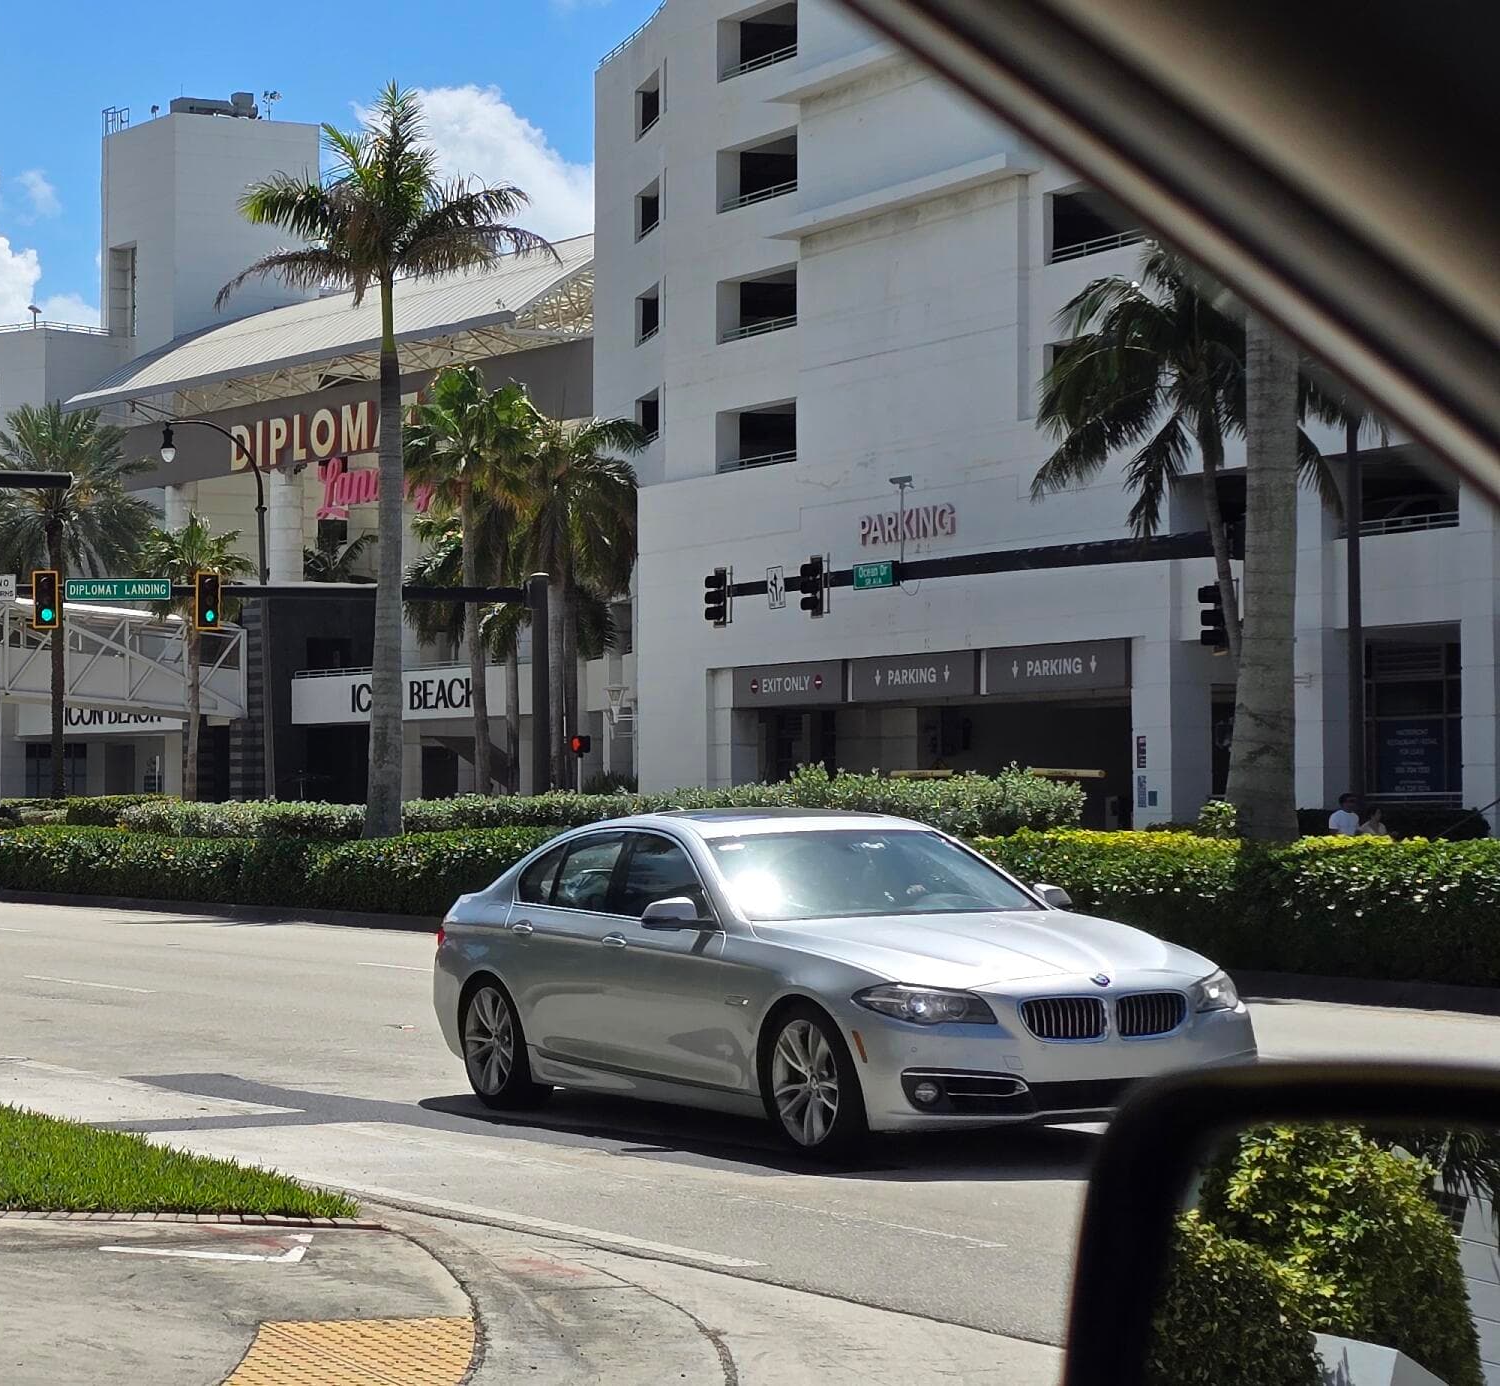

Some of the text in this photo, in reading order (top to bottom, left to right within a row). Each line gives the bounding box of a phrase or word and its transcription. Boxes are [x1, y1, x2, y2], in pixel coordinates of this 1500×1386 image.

[230, 391, 419, 472] DIPLOM
[859, 502, 957, 547] PARKING
[858, 564, 888, 578] Ocean Dr
[69, 584, 167, 595] DIPLOMAT LANDING
[887, 667, 937, 685] PARKING
[1026, 657, 1083, 677] PARKING
[762, 675, 810, 693] EXIT ONLY
